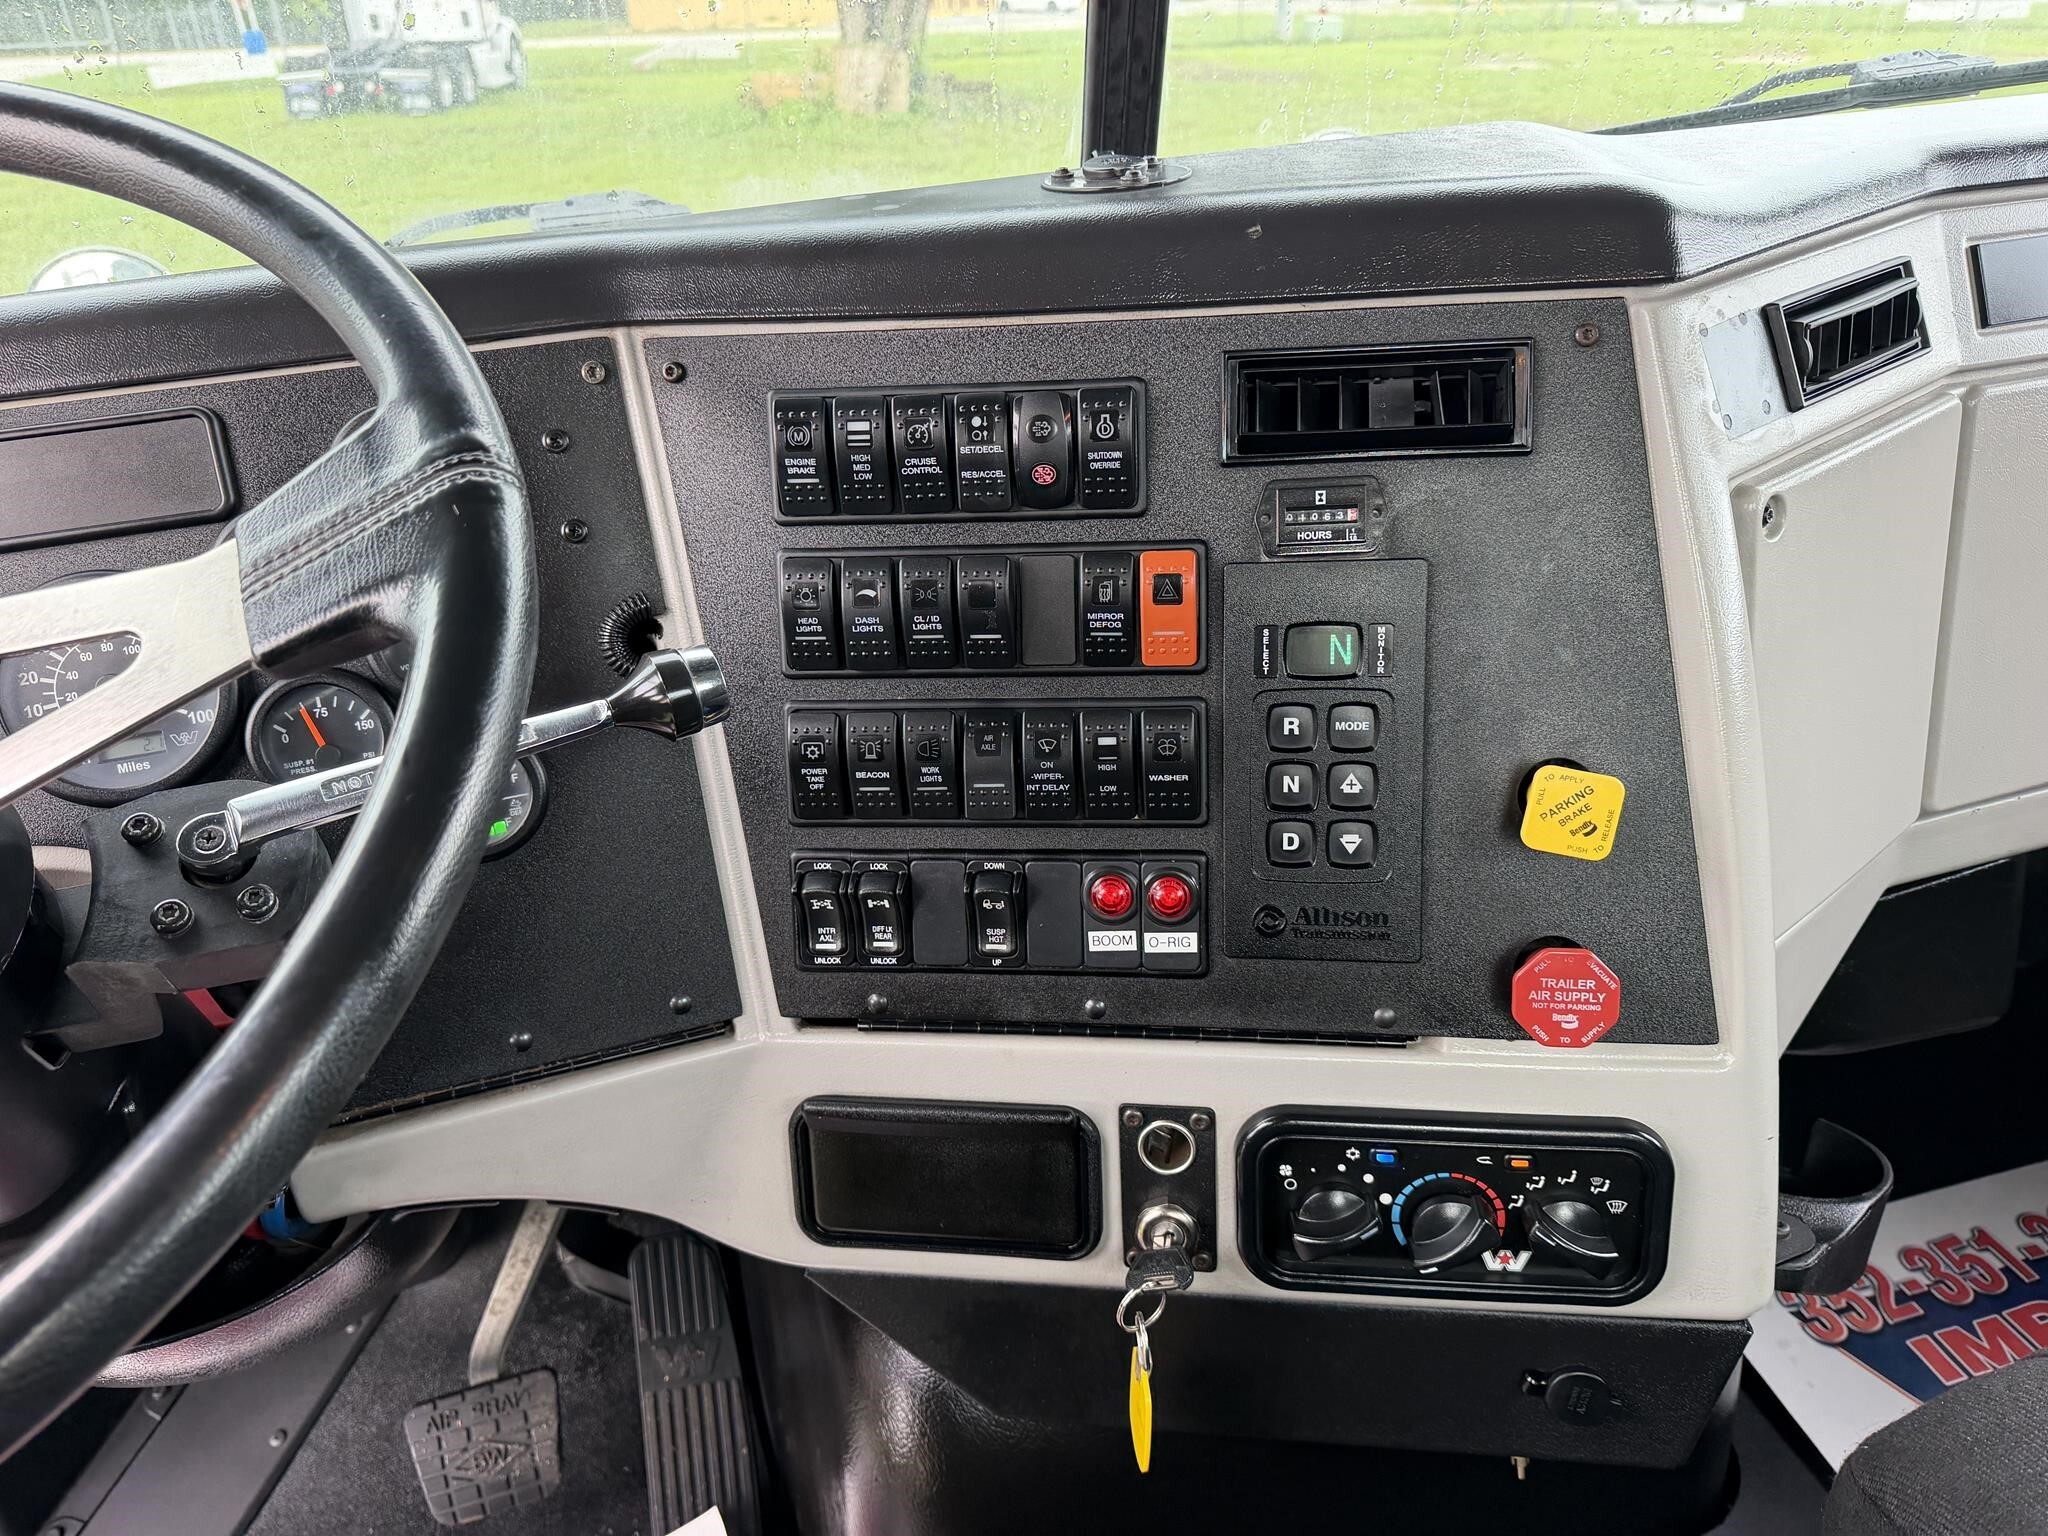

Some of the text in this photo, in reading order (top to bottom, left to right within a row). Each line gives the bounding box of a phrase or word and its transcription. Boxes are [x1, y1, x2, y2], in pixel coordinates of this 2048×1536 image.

[960, 445, 1004, 455] SET/DECEL
[851, 454, 871, 463] HIGH
[1087, 451, 1123, 461] SHUTDOWN
[784, 457, 817, 467] ENGINE
[905, 457, 937, 467] CRUISE
[1090, 460, 1121, 470] OVERRIDE
[787, 466, 816, 475] BRAKE
[853, 463, 871, 472] MED
[901, 465, 943, 475] CONTROL
[854, 472, 873, 481] LOW
[961, 469, 1006, 479] RES/ACCEL
[1297, 530, 1332, 540] HOURS
[797, 617, 819, 626] HEAD
[855, 616, 880, 625] DASH
[1087, 612, 1124, 621] MIRROR
[796, 624, 823, 633] LIGHTS
[852, 624, 884, 634] LIGHTS
[912, 623, 943, 631] LIGHTS
[1089, 620, 1122, 629] DEFOG
[100, 642, 114, 652] 80
[122, 644, 141, 655] 100
[1262, 628, 1270, 675] SELECT
[1330, 634, 1352, 665] N
[1377, 626, 1386, 674] MONITOR
[79, 652, 93, 662] 60
[18, 671, 39, 686] 20
[65, 670, 79, 680] 40
[65, 692, 78, 702] 20
[23, 703, 44, 720] 10
[187, 708, 215, 725] 100
[313, 707, 328, 718] 75
[354, 719, 375, 731] 150
[1283, 717, 1300, 735] R
[1335, 721, 1370, 731] MODE
[282, 733, 289, 744] 0
[981, 743, 997, 752] AXLE
[363, 751, 375, 759] PSI
[117, 761, 151, 774] Miles
[1040, 761, 1054, 769] ON
[1098, 764, 1117, 772] HIGH
[801, 767, 828, 776] POWER
[855, 771, 890, 779] BEACON
[921, 766, 940, 775] WORK
[330, 771, 375, 796] NOT
[805, 775, 826, 783] TAKE
[919, 774, 943, 783] LIGHTS
[1148, 774, 1190, 783] WASHER
[809, 782, 825, 791] OFF
[1026, 783, 1070, 792] INT DELAY
[1099, 785, 1117, 793] LOW
[1282, 775, 1300, 793] N
[1536, 773, 1585, 806] PULL TO APPLY
[1539, 785, 1595, 822] PARKING
[1558, 802, 1593, 827] BRAKE
[1567, 808, 1615, 855] PUSH TO RELEASE
[1569, 820, 1594, 837] Bendix
[1282, 832, 1300, 850] D
[813, 862, 832, 870] LOCK
[869, 862, 888, 870] LOCK
[983, 862, 1005, 870] DOWN
[817, 927, 836, 935] INTR
[986, 928, 1006, 936] SUSP
[818, 934, 835, 942] AXL
[874, 932, 892, 941] REAR
[988, 935, 1004, 943] HGT
[1091, 935, 1134, 948] BOOM
[1148, 937, 1191, 948] O-RIG
[814, 956, 842, 965] UNLOCK
[869, 957, 898, 965] UNLOCK
[992, 959, 1002, 967] UP
[1534, 959, 1551, 974] PULL
[1540, 977, 1596, 989] TRAILER
[1528, 990, 1606, 1003] AIR SUPPLY
[1552, 1013, 1578, 1021] Bendix
[1532, 1024, 1550, 1042] PUSH
[1581, 1021, 1606, 1043] SUPPLY
